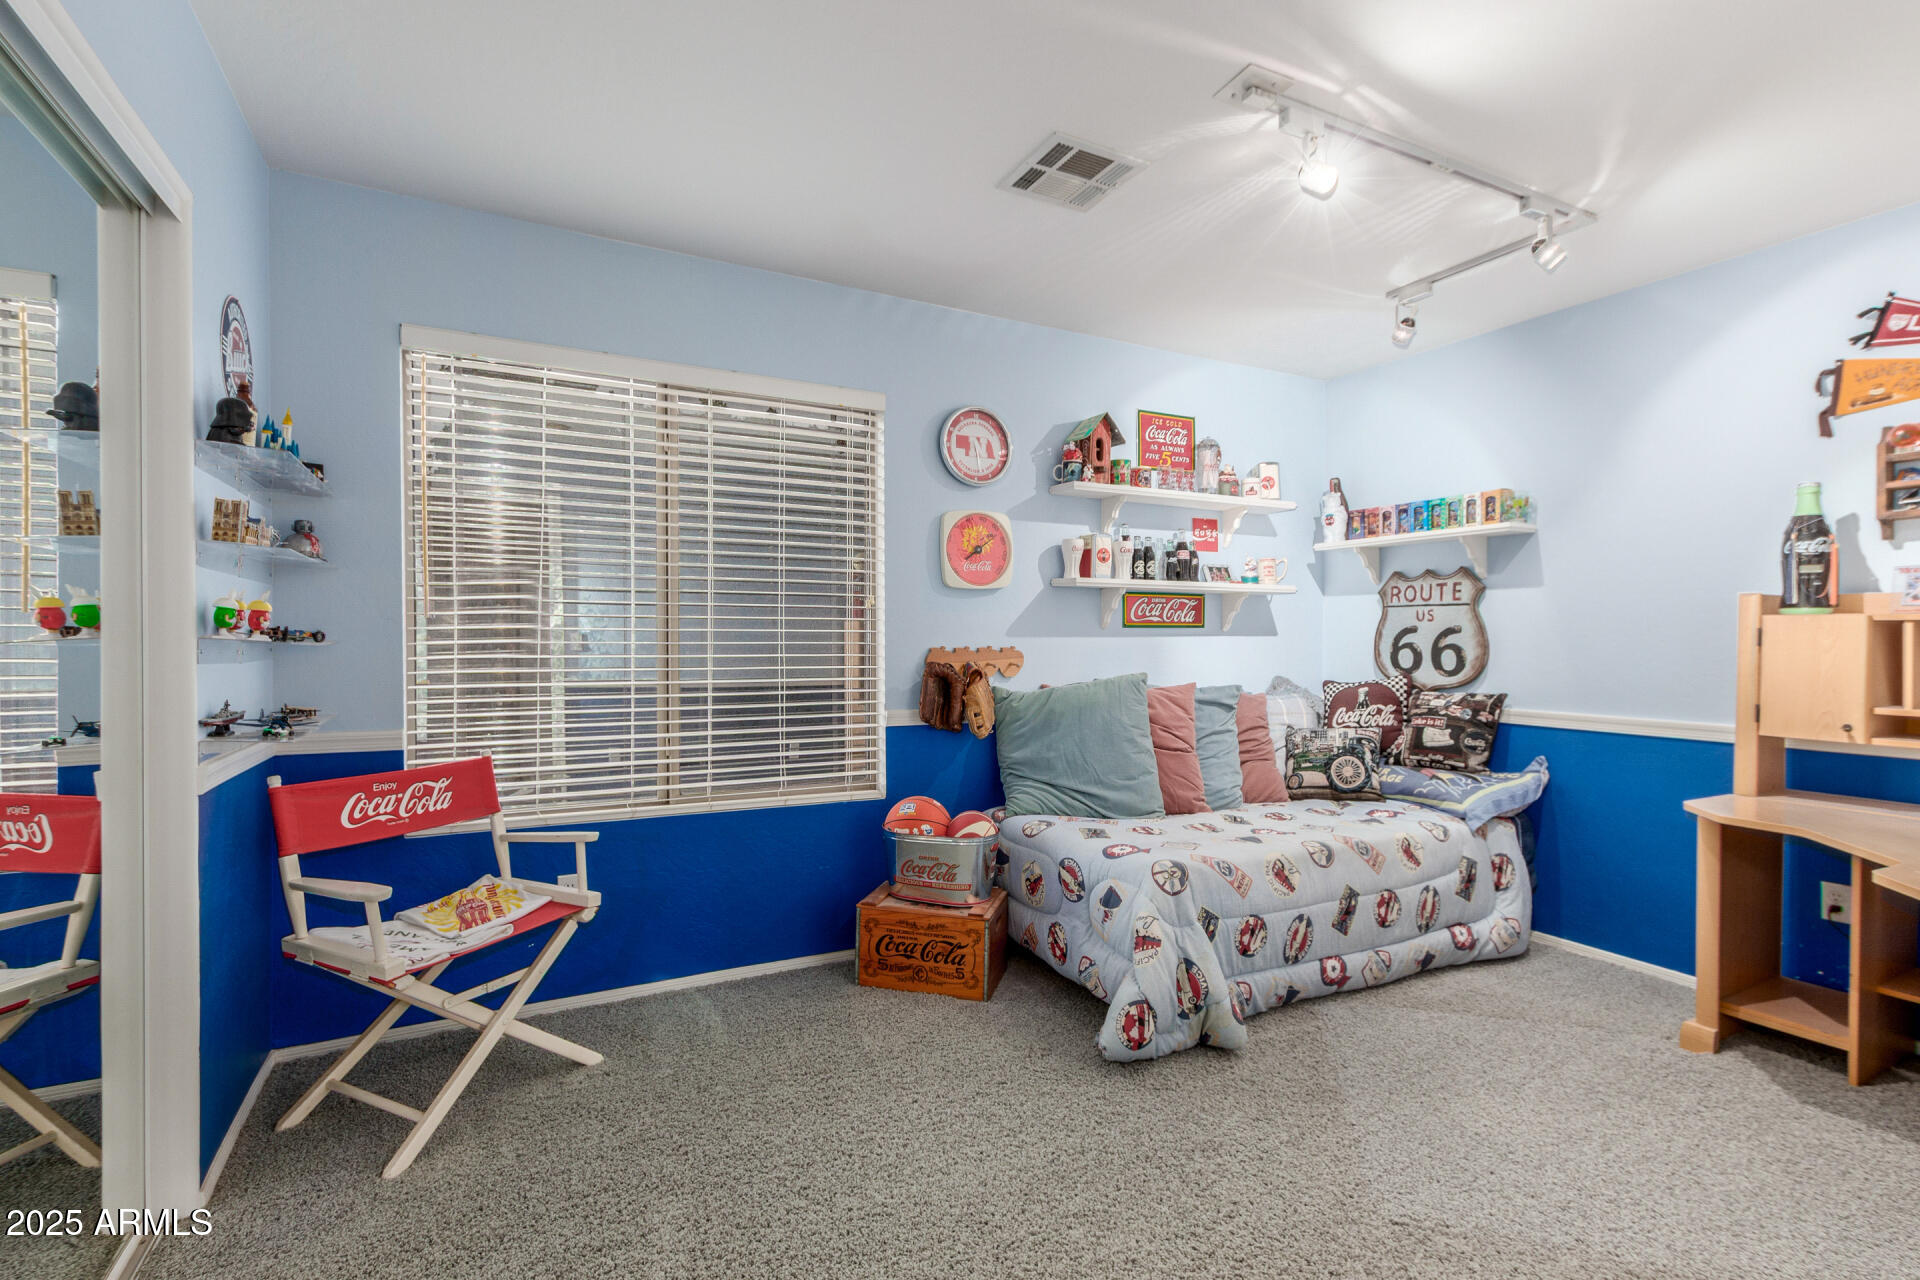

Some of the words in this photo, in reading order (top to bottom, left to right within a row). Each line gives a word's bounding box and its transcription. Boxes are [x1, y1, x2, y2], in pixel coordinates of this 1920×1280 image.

[1166, 420, 1183, 428] COLD
[1145, 425, 1188, 446] Coca-Cola
[1145, 452, 1160, 460] FIVE
[1159, 451, 1172, 467] 5
[1172, 455, 1190, 463] CENTS
[1161, 445, 1185, 453] ALWAYS
[963, 560, 992, 572] Coca-Cola
[1390, 582, 1463, 603] ROUTE
[1130, 597, 1198, 622] Coca-Cola
[1416, 609, 1435, 622] US
[1390, 625, 1467, 677] 66
[1332, 704, 1397, 728] Coca-Cola
[372, 782, 397, 792] Enjoy
[340, 776, 453, 829] Coca-Cola
[901, 859, 960, 882] Coca-Cola
[875, 934, 969, 968] Coca-Cola
